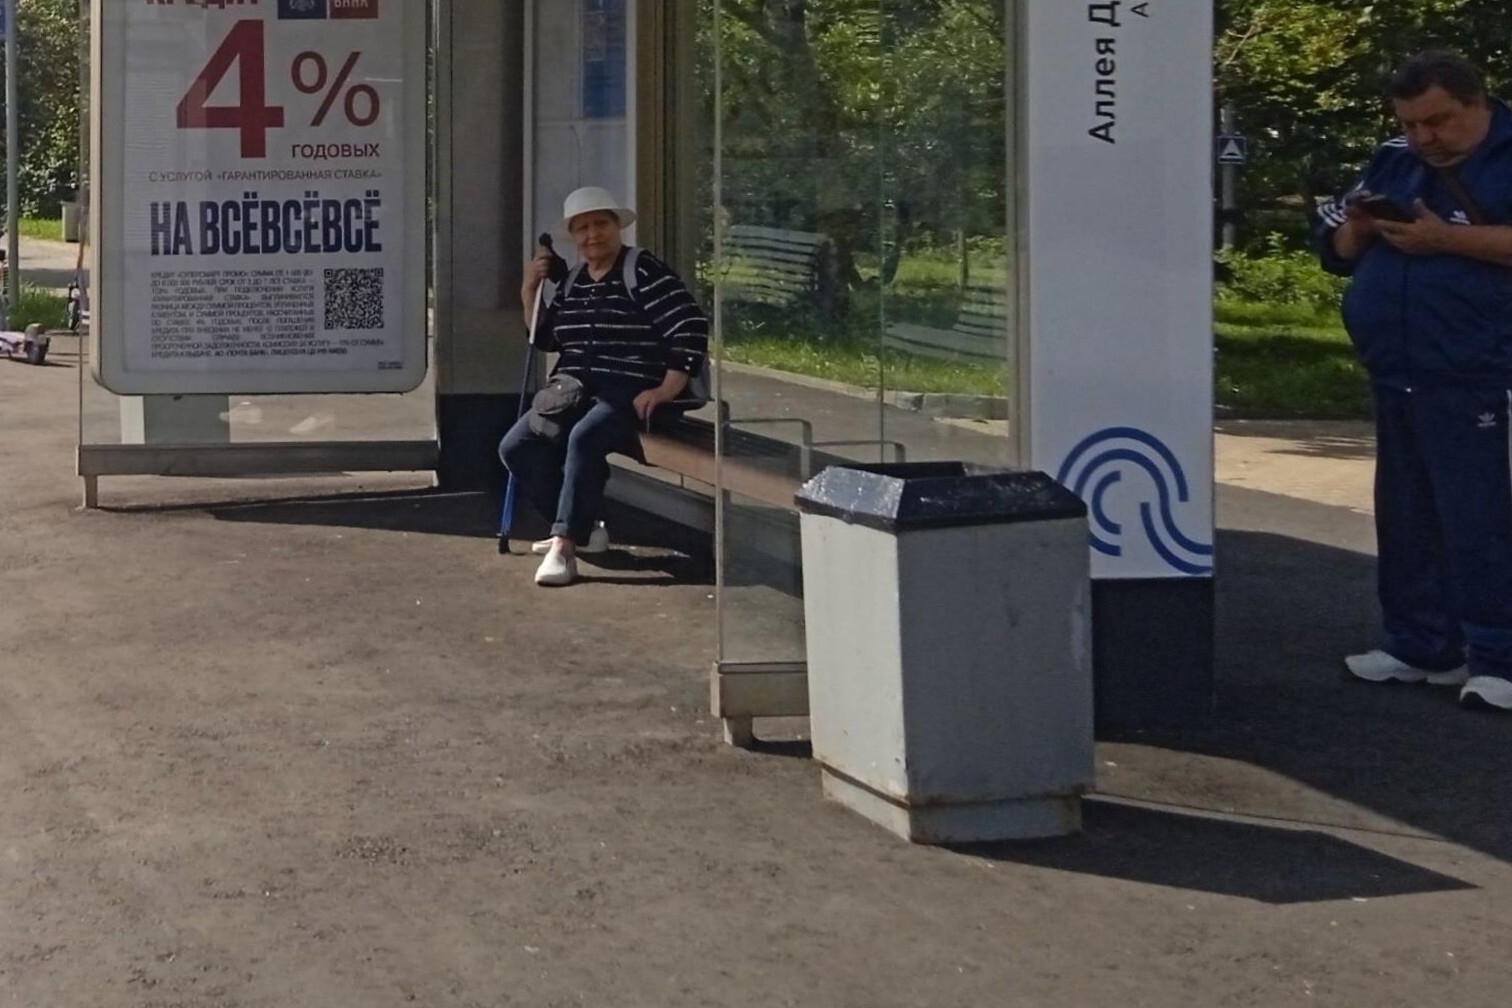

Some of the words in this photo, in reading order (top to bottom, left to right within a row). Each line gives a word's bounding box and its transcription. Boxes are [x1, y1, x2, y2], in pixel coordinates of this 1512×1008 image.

[1088, 36, 1118, 145] Аллея
[291, 142, 381, 162] ГОДОВЫХ
[159, 170, 214, 182] УСЛУГОЙ
[150, 201, 193, 256] НА
[199, 189, 383, 255] ВСЁВСЁВСЁ
